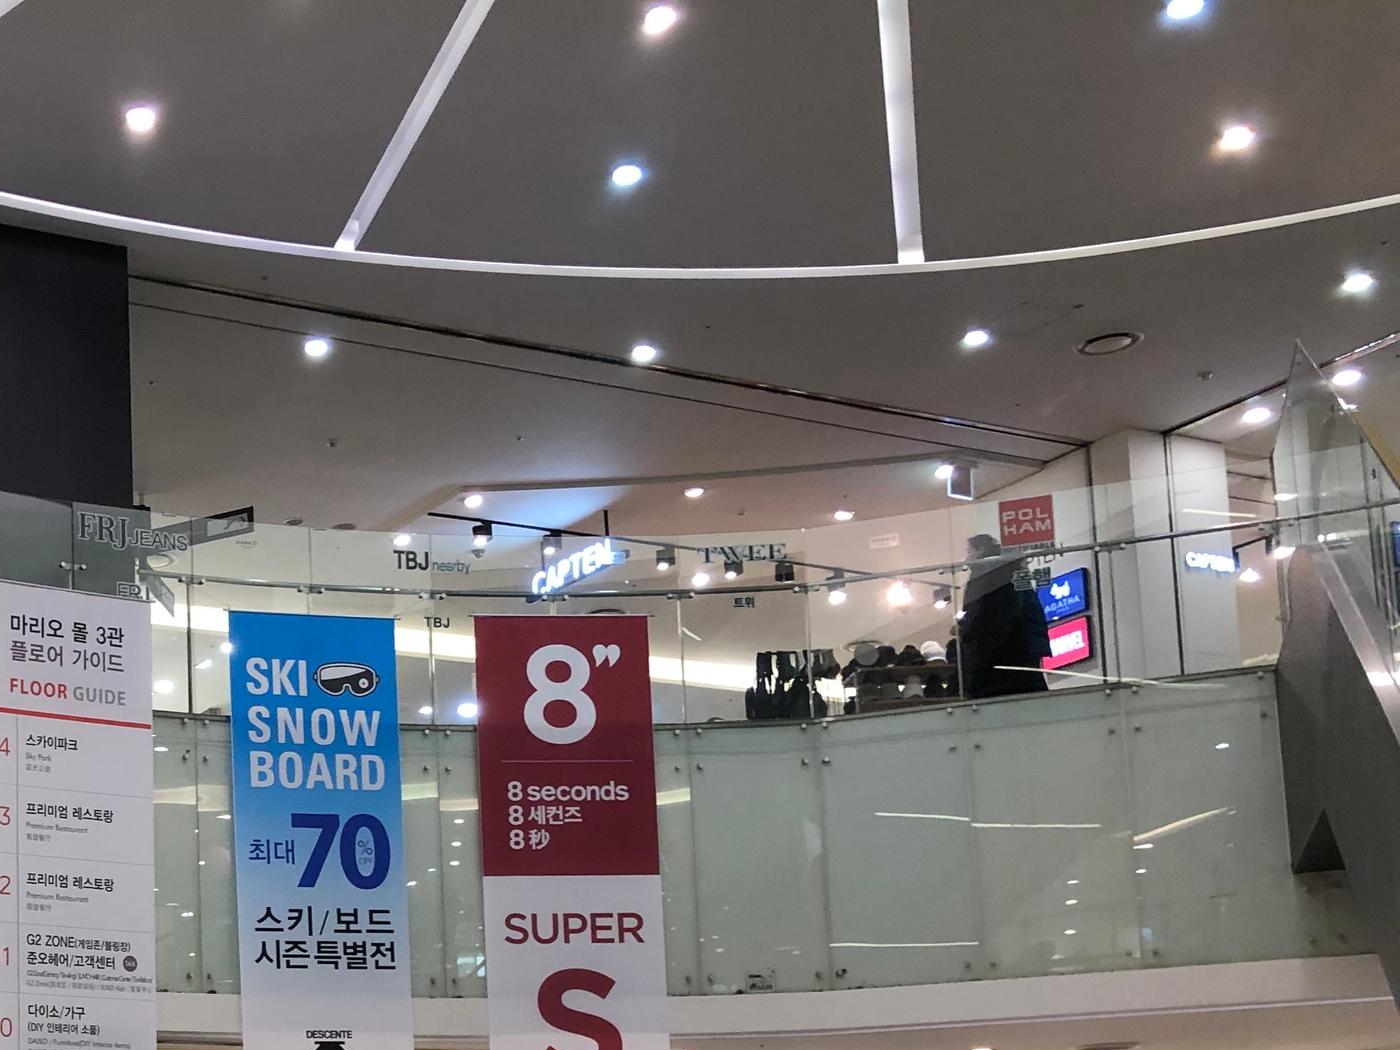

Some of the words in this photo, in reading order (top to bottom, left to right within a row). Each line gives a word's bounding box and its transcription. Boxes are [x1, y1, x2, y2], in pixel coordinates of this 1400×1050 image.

[1002, 508, 1049, 523] POL
[78, 511, 129, 550] FRJ
[129, 529, 188, 551] JEANS
[1003, 520, 1051, 536] HAM
[393, 549, 429, 571] TBJ
[432, 559, 471, 574] nearby
[697, 543, 787, 563] TWEE
[530, 538, 614, 596] CAPTEN
[733, 596, 755, 608] 트위
[1044, 595, 1081, 613] AGATHA
[10, 614, 64, 638] 마리오
[72, 622, 88, 644] 몰
[96, 626, 125, 648] 3관
[424, 616, 450, 628] TBJ
[10, 640, 63, 667] 플로어
[72, 650, 125, 672] 가이드
[246, 657, 308, 697] SKI
[10, 678, 68, 699] FLOOR
[73, 686, 126, 706] GUIDE
[248, 705, 380, 747] SNOW
[25, 734, 78, 751] 스카이파크
[250, 750, 385, 791] BOARD
[507, 781, 522, 801] 8
[526, 781, 629, 801] seconds
[26, 803, 68, 819] 프리미엄
[73, 807, 114, 824] 레스토랑
[508, 805, 524, 825] 8
[528, 805, 583, 826] 세컨즈
[509, 830, 525, 850] 8
[529, 828, 550, 850] 秒
[248, 839, 296, 865] 최대
[291, 812, 391, 890] 70
[26, 873, 69, 889] 프리미엄
[73, 876, 115, 892] 레스토랑
[254, 906, 395, 937] 스키/보드
[505, 912, 645, 944] SUPER
[27, 934, 41, 946] G2
[27, 951, 115, 970] 준오헤어/고객센터
[255, 939, 397, 971] 시즌특별전
[28, 1004, 86, 1020] 다이소/가구
[47, 1023, 79, 1035] 인테리어
[306, 1030, 353, 1040] DESCENTE
